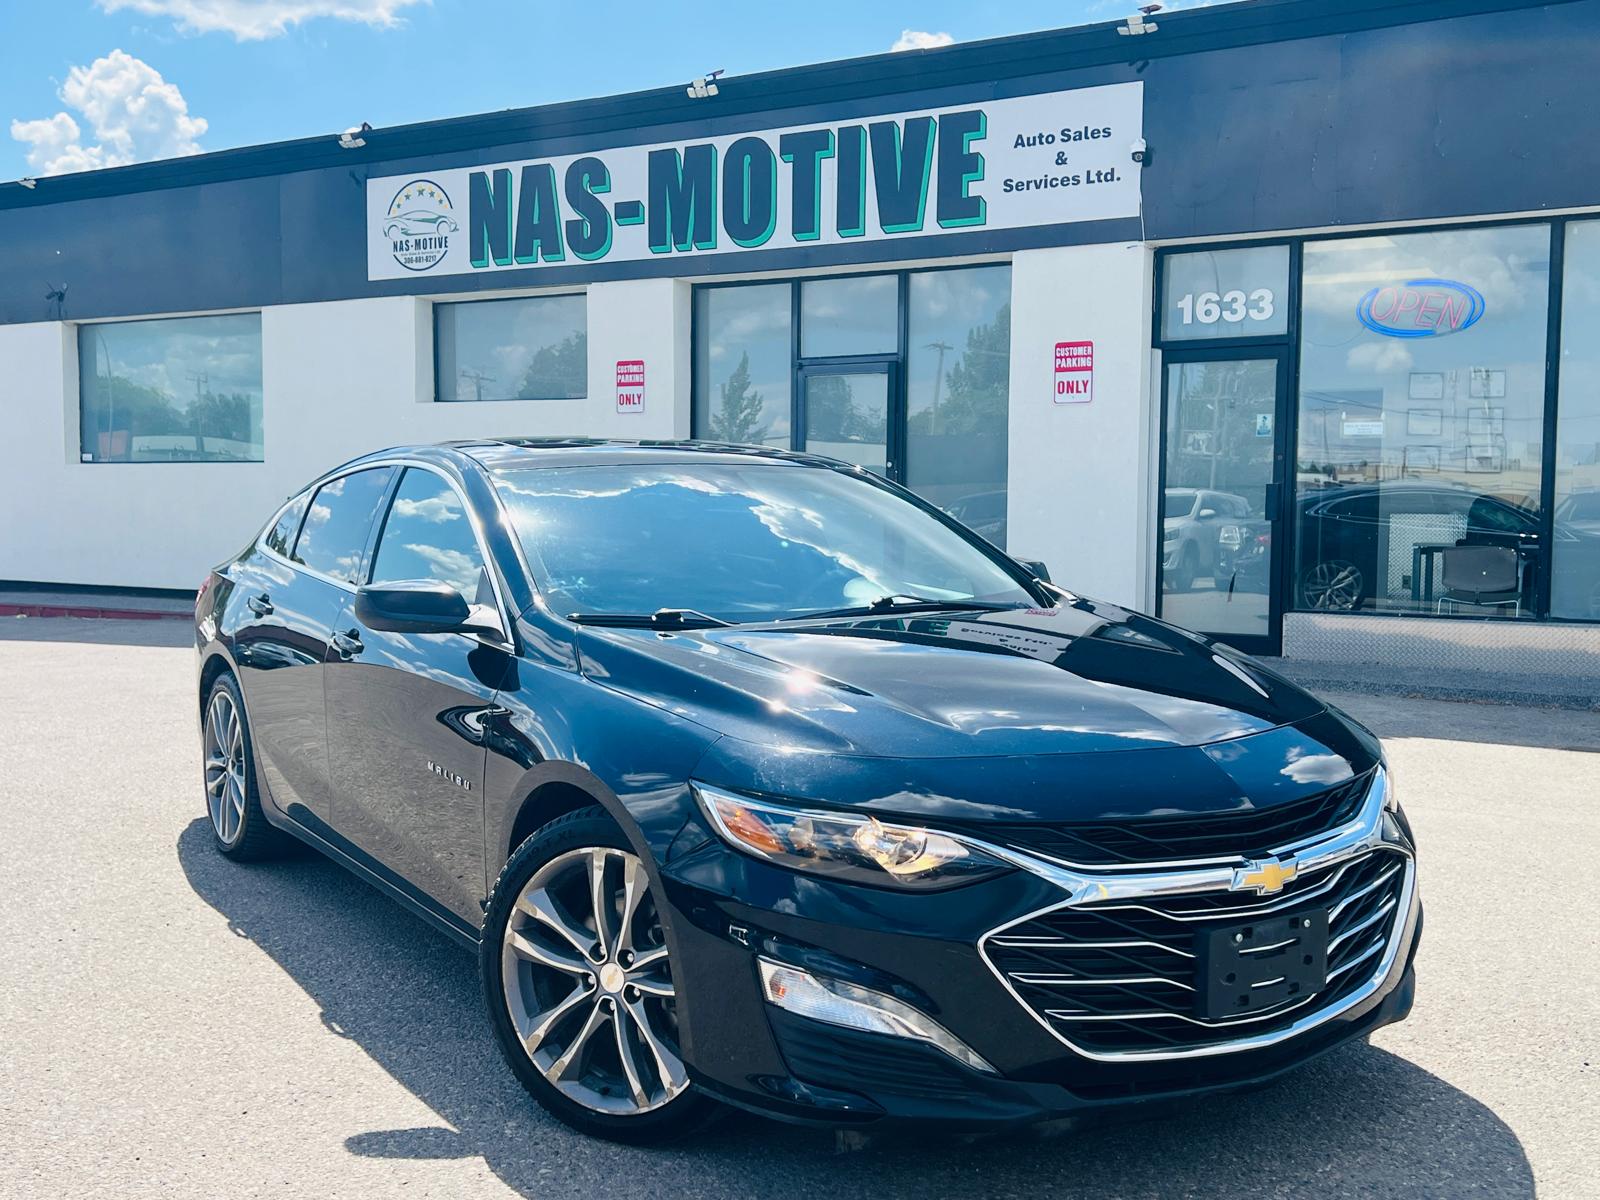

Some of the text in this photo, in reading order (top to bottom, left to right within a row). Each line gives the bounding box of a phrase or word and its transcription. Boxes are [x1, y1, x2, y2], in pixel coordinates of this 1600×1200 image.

[1013, 126, 1112, 148] Auto Sales
[1055, 151, 1068, 166] &
[469, 109, 987, 269] NAS-MOTIVE
[1003, 168, 1121, 193] Services Ltd.
[393, 236, 448, 252] NAS-MOTIVE
[1177, 288, 1275, 325] 1633
[1370, 287, 1466, 329] OPEN
[1056, 346, 1091, 356] CUSTOMER
[1056, 357, 1091, 368] PARKING
[1057, 380, 1089, 394] ONLY
[619, 393, 642, 405] ONLY
[427, 760, 471, 791] MALIBU
